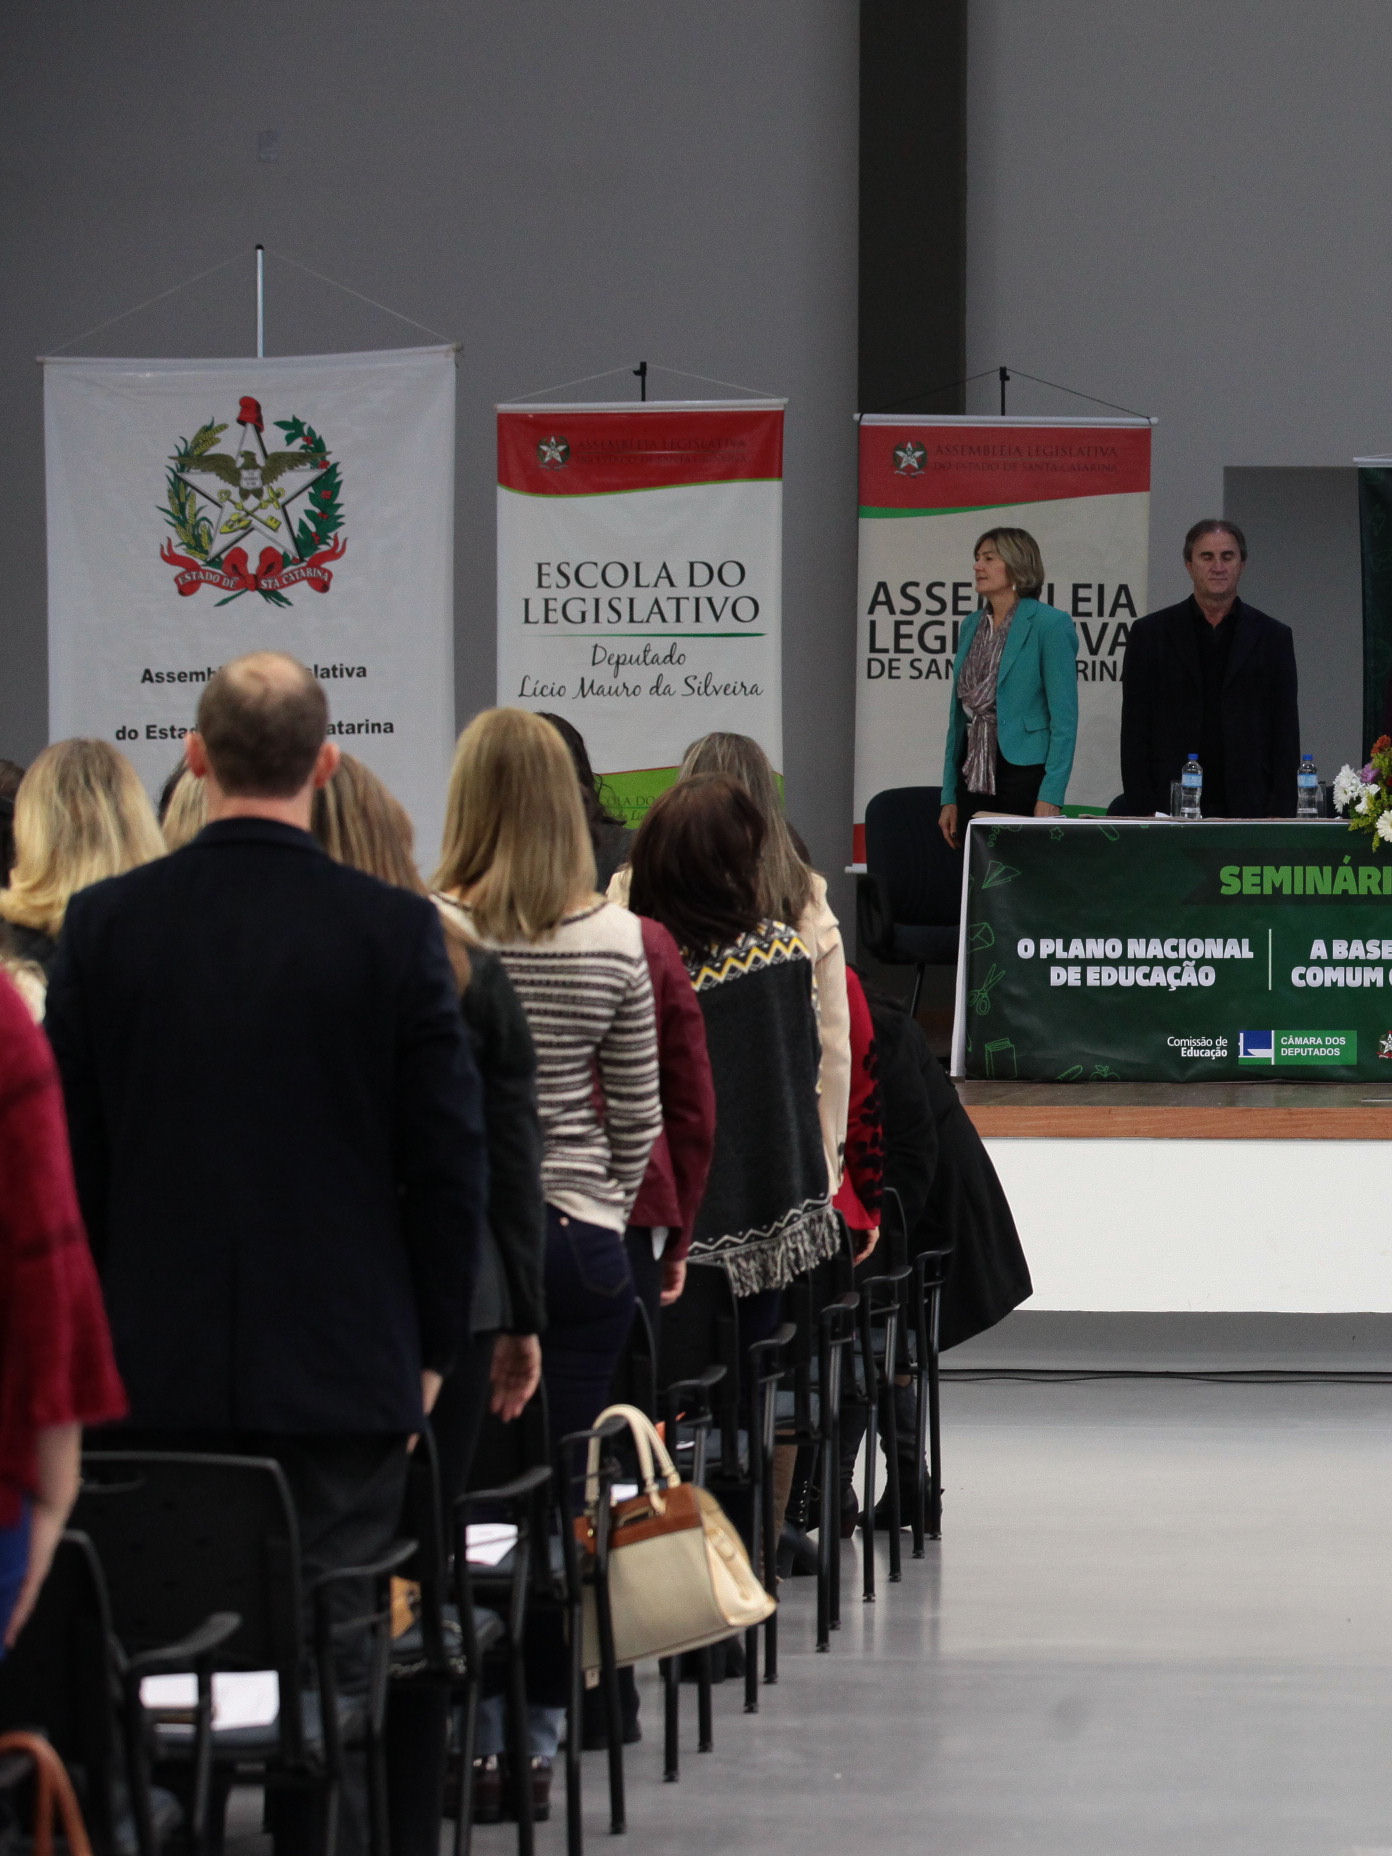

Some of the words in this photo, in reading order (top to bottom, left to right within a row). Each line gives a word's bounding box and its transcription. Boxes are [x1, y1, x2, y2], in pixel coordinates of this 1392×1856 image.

[178, 571, 220, 587] ESTADO
[221, 576, 237, 588] DE
[282, 567, 329, 585] CATARINA
[534, 561, 678, 589] ESCOLA
[687, 560, 746, 588] DO
[522, 595, 760, 625] LEGISLATIVO
[591, 642, 686, 678] Deputado
[866, 657, 901, 680] DE
[518, 674, 566, 698] Lício
[572, 677, 642, 699] Mauro
[649, 673, 677, 697] da
[681, 672, 764, 697] Silveira
[115, 725, 139, 741] do
[326, 719, 395, 735] atarina
[1017, 938, 1035, 959] O
[1039, 938, 1123, 959] PLANO
[1127, 938, 1254, 959] NACIONAL
[1309, 939, 1328, 960] A
[1050, 966, 1082, 987] DE
[1086, 960, 1216, 991] EDUCAÇÃO
[1291, 966, 1384, 987] COMUM
[1167, 1035, 1214, 1047] Comissão
[1215, 1036, 1228, 1047] de
[1281, 1034, 1323, 1045] CÂMARA
[1325, 1036, 1346, 1045] DOS
[1181, 1047, 1228, 1060] Educação
[1281, 1047, 1341, 1056] DEPUTADOS
